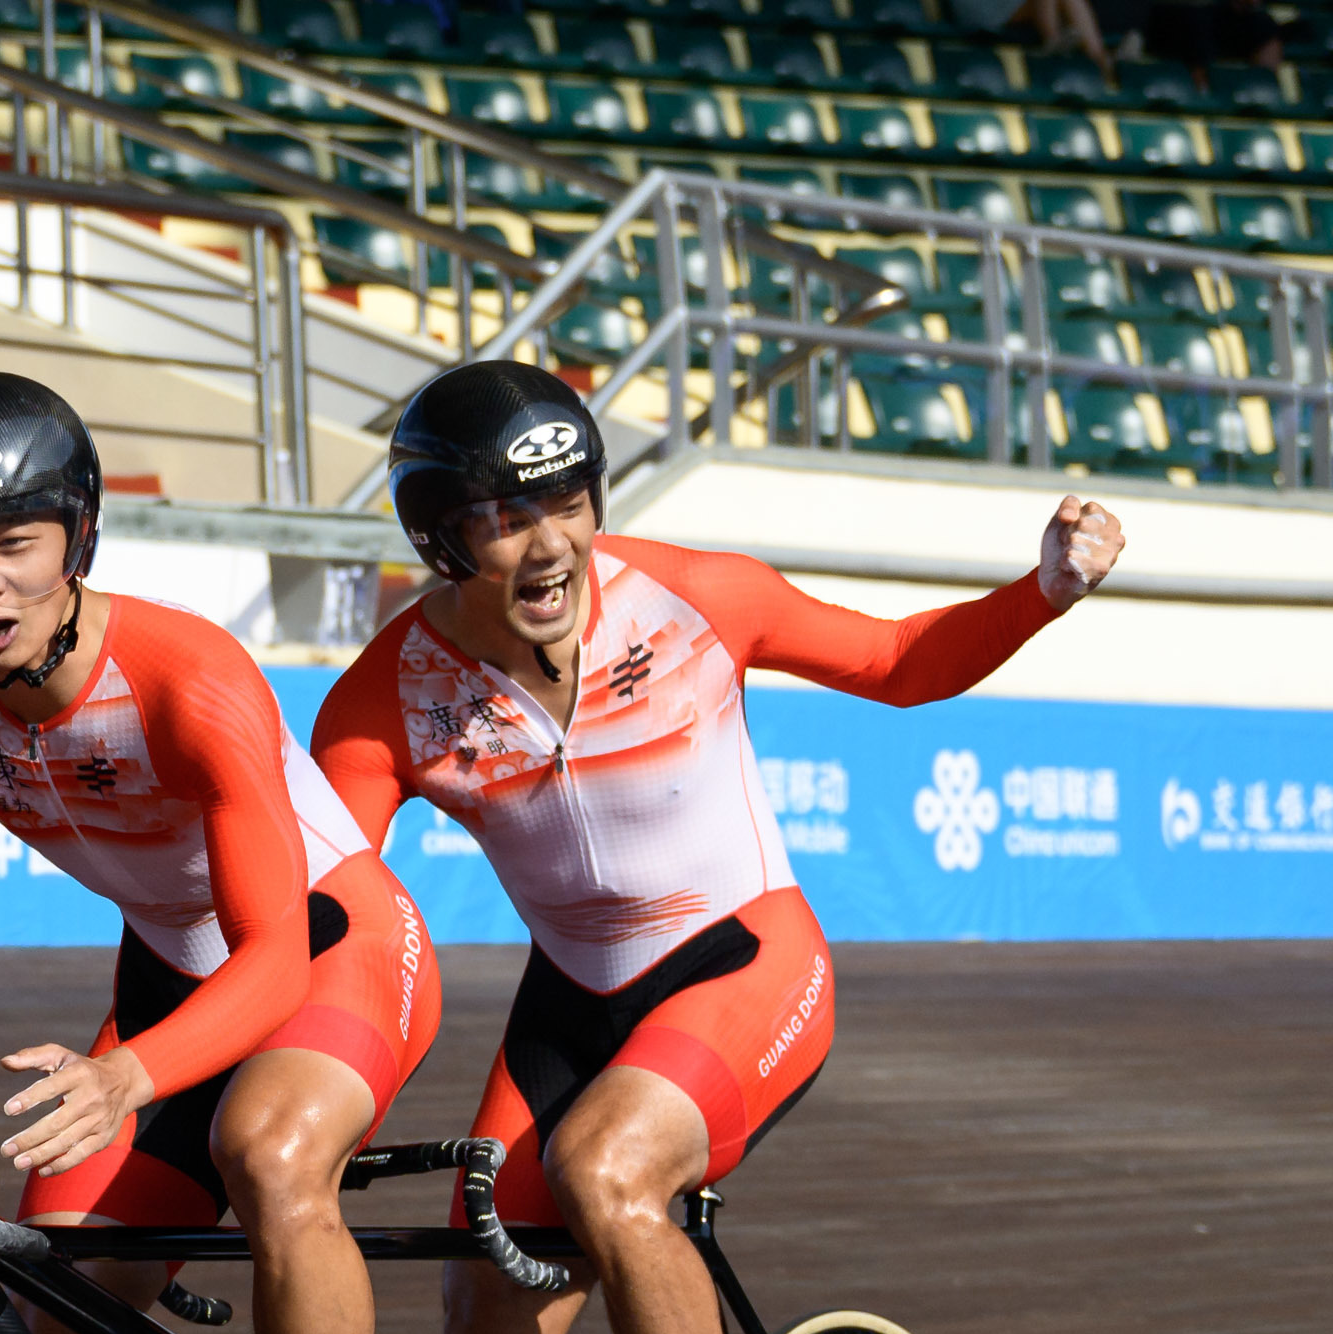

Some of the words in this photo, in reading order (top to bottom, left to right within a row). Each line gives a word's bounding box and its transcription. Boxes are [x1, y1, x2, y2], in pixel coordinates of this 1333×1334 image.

[518, 449, 587, 482] Kabuto
[1002, 765, 1118, 820] 中国联通
[395, 894, 421, 975] DONG
[758, 1015, 803, 1078] GUANG
[798, 954, 826, 1020] DONG
